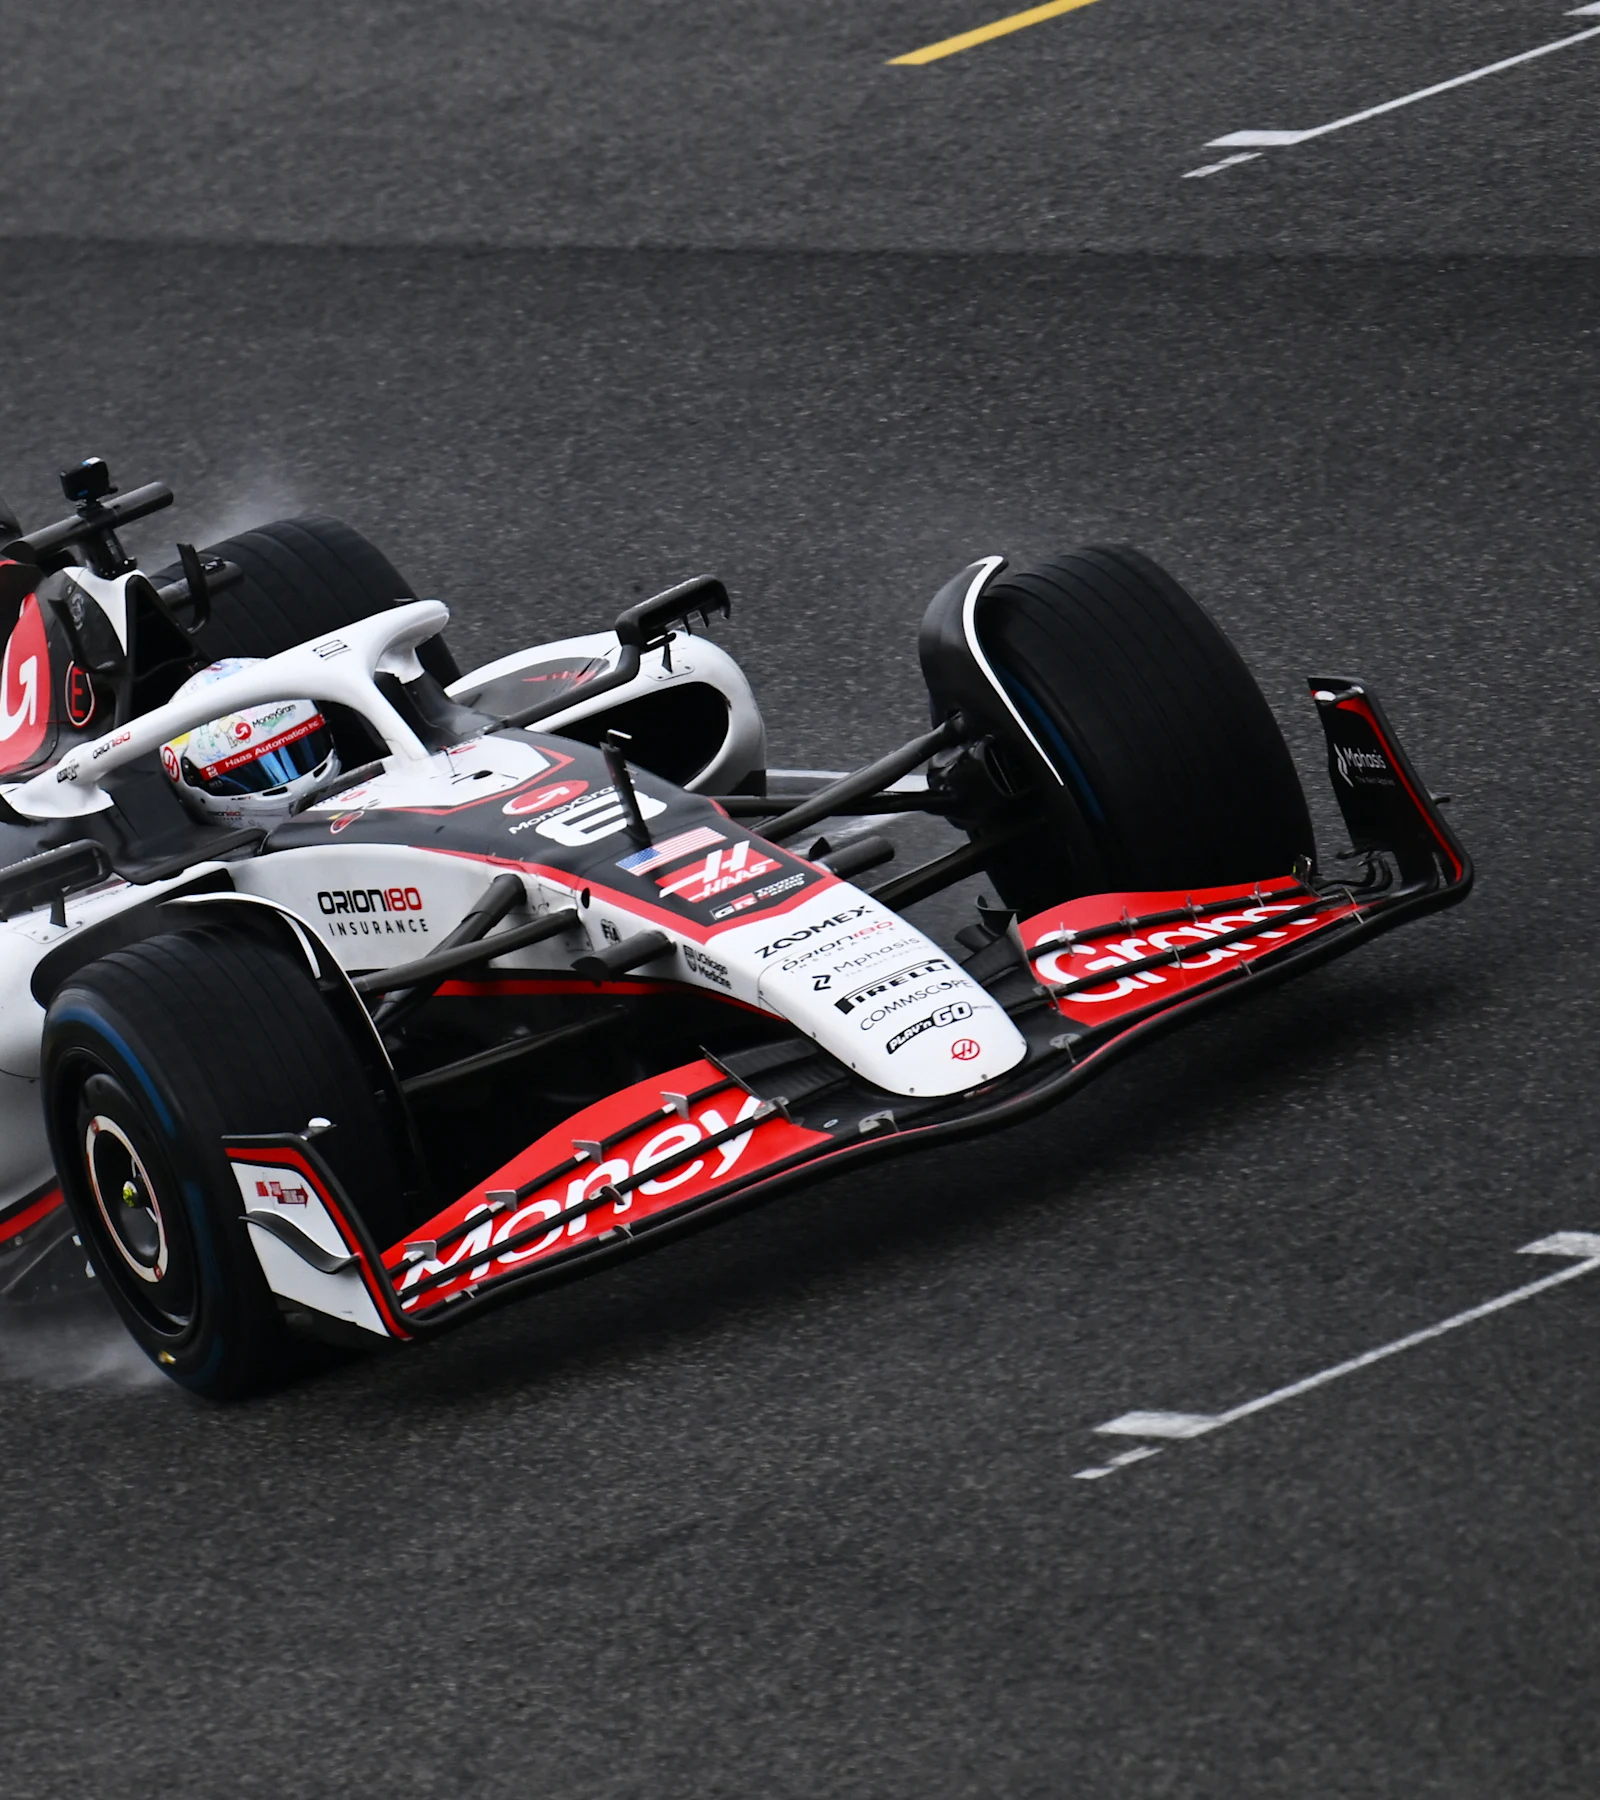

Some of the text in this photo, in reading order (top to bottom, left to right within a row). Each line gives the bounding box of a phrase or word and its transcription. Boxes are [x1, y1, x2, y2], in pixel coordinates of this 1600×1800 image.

[252, 704, 297, 727] MoneyGram
[224, 720, 320, 768] Haas Automation Inc
[1342, 746, 1387, 774] Mphasis
[509, 784, 619, 835] MoneyGra
[317, 887, 423, 915] ORION180
[689, 859, 776, 903] HAAS
[328, 918, 430, 937] INSURANCE
[713, 896, 758, 919] GR
[755, 905, 876, 959] ZOOMEX
[782, 920, 894, 972] ORION180
[833, 936, 921, 974] Mphasis
[1034, 903, 1318, 1003] Gram
[698, 963, 732, 990] Medicine
[834, 959, 952, 1014] PIRELLI
[860, 979, 974, 1031] COMMSCOPE
[401, 1096, 761, 1311] Money
